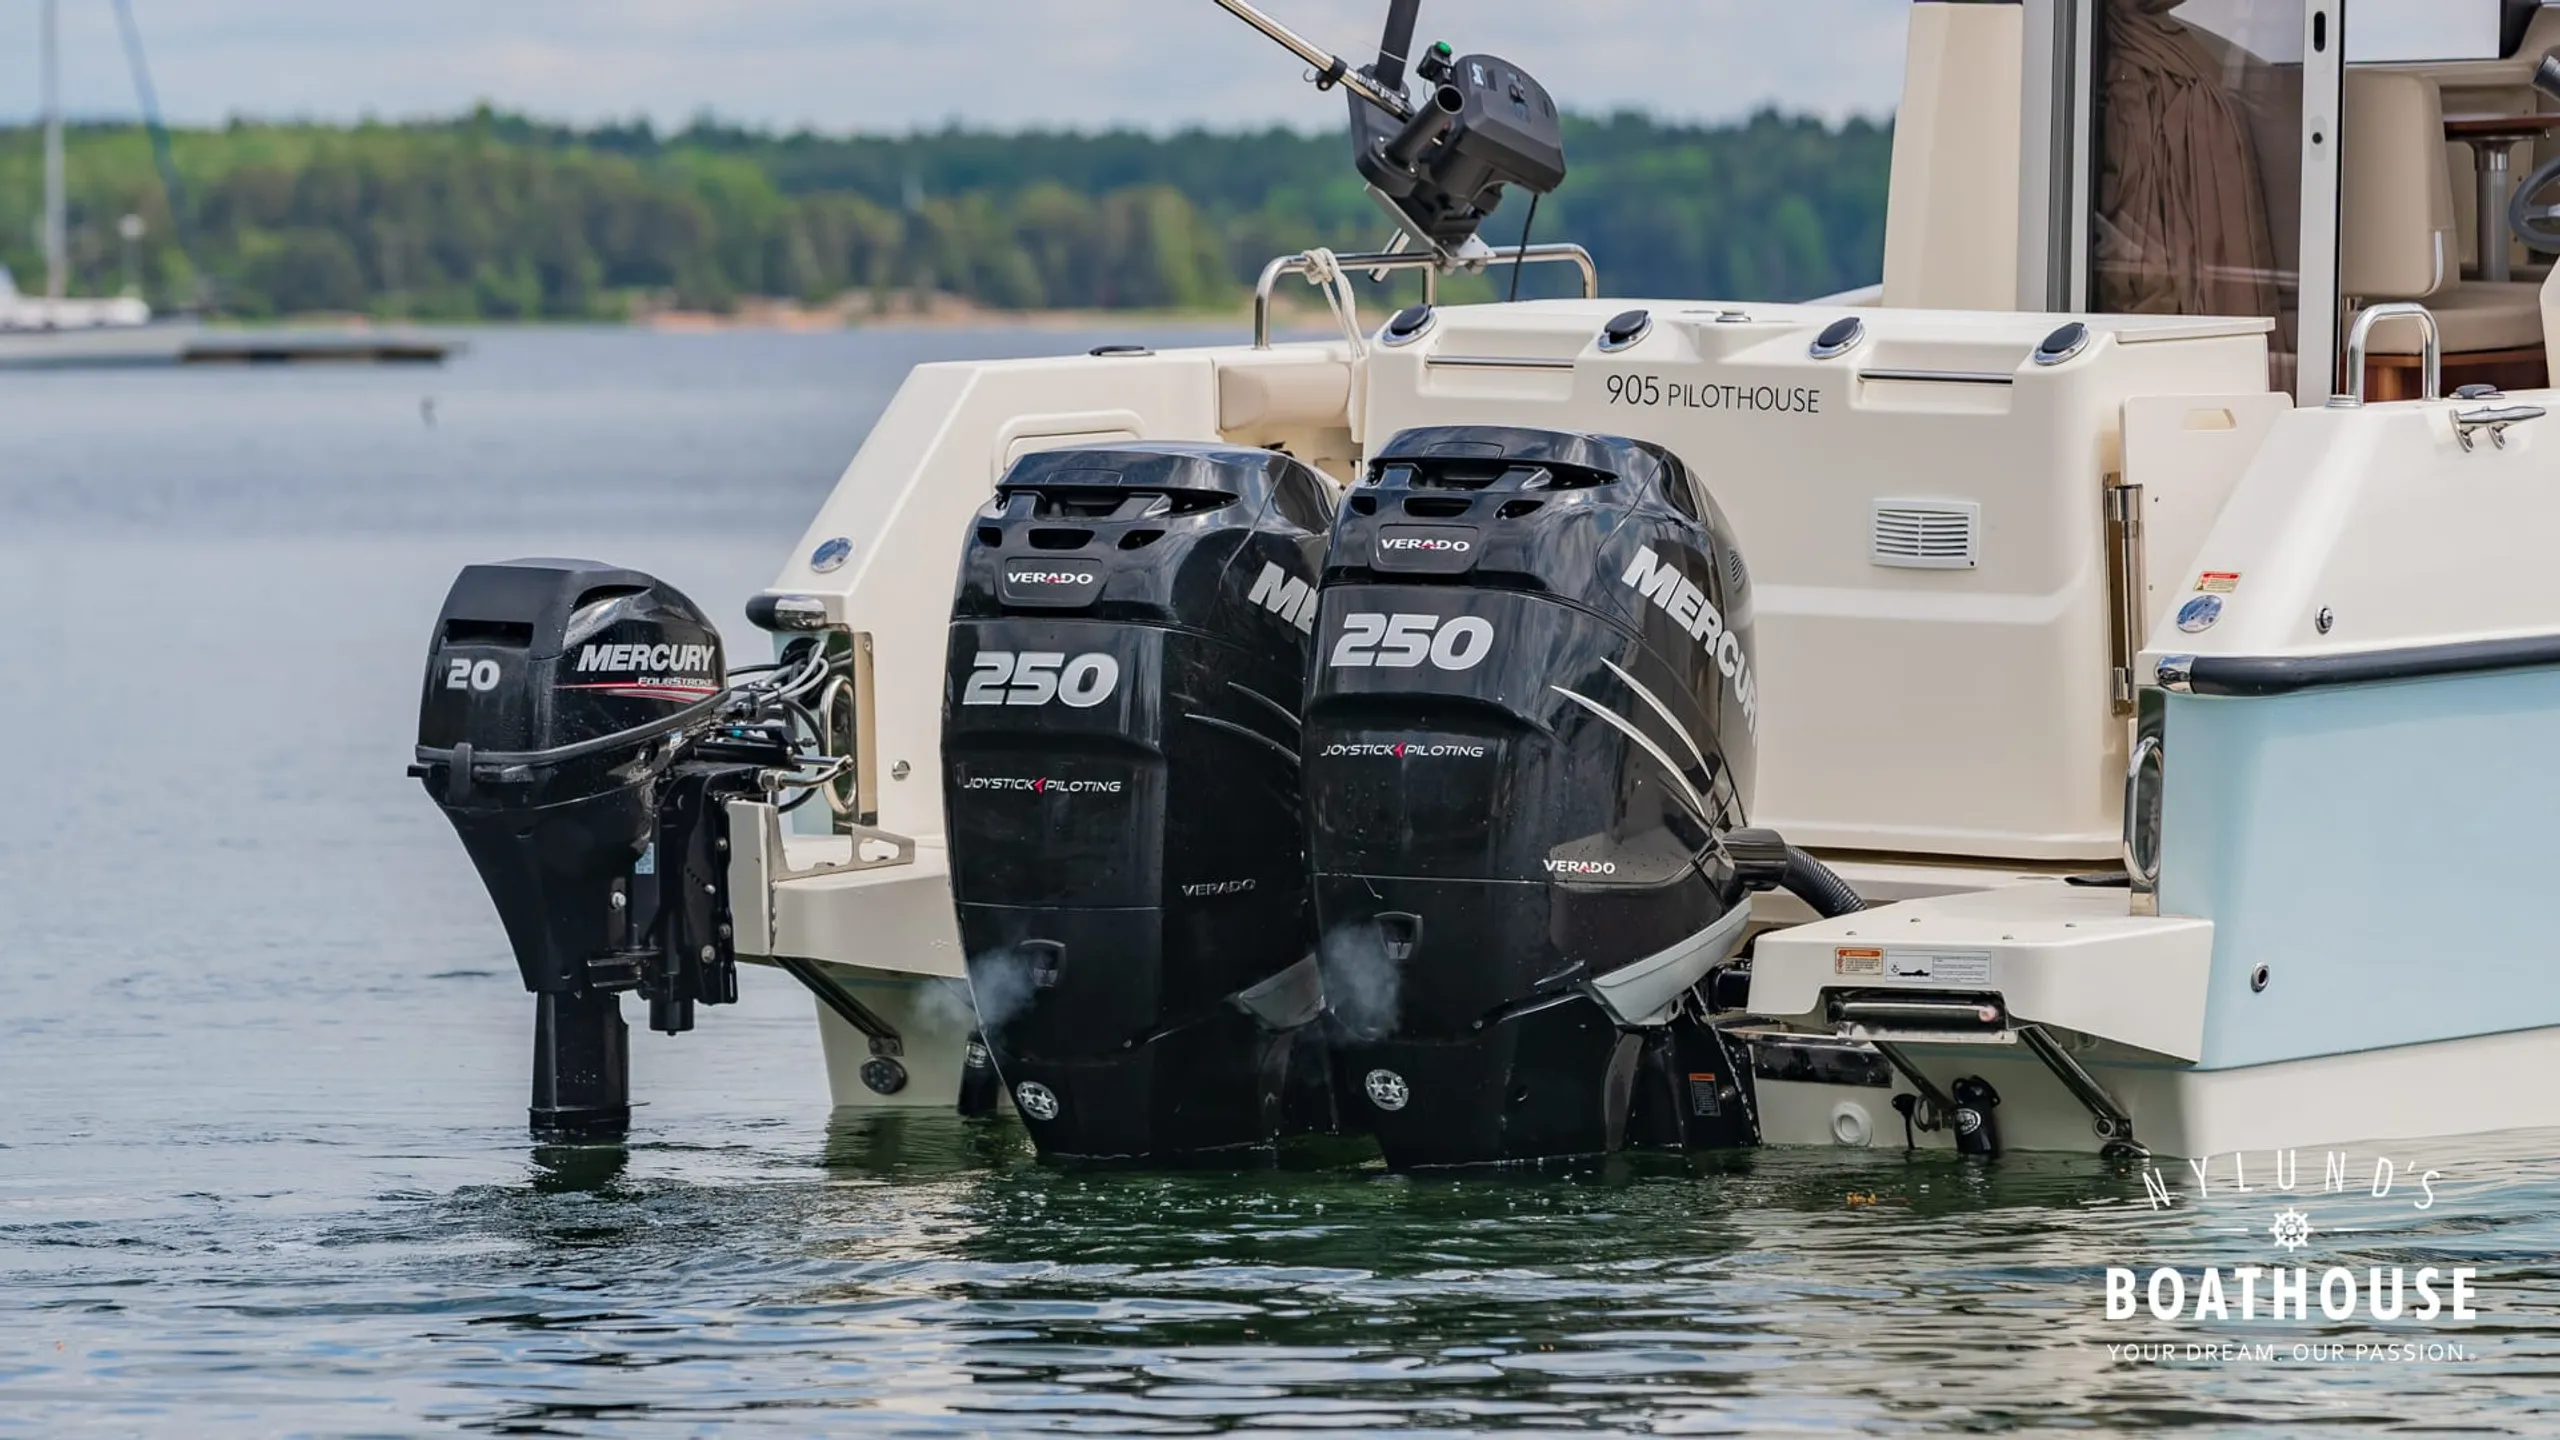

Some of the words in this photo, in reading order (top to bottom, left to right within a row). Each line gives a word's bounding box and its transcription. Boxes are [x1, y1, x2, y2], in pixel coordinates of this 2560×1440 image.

[1607, 374, 1660, 405] 905
[1668, 383, 1820, 413] PILOTHOUSE
[1381, 538, 1470, 552] VERADO
[1008, 572, 1094, 584] VERADO
[1330, 613, 1494, 670] 250
[1621, 544, 1758, 747] MERCUR
[577, 644, 716, 672] MERCURY
[446, 658, 500, 691] 20
[962, 651, 1120, 708] 250
[1321, 744, 1396, 757] JOYSTICK
[1404, 744, 1484, 758] PILOTING
[963, 778, 1034, 790] JOYSTICK
[1045, 779, 1121, 793] PILOTING
[1543, 858, 1616, 875] VERADO
[1181, 878, 1256, 897] VERADO
